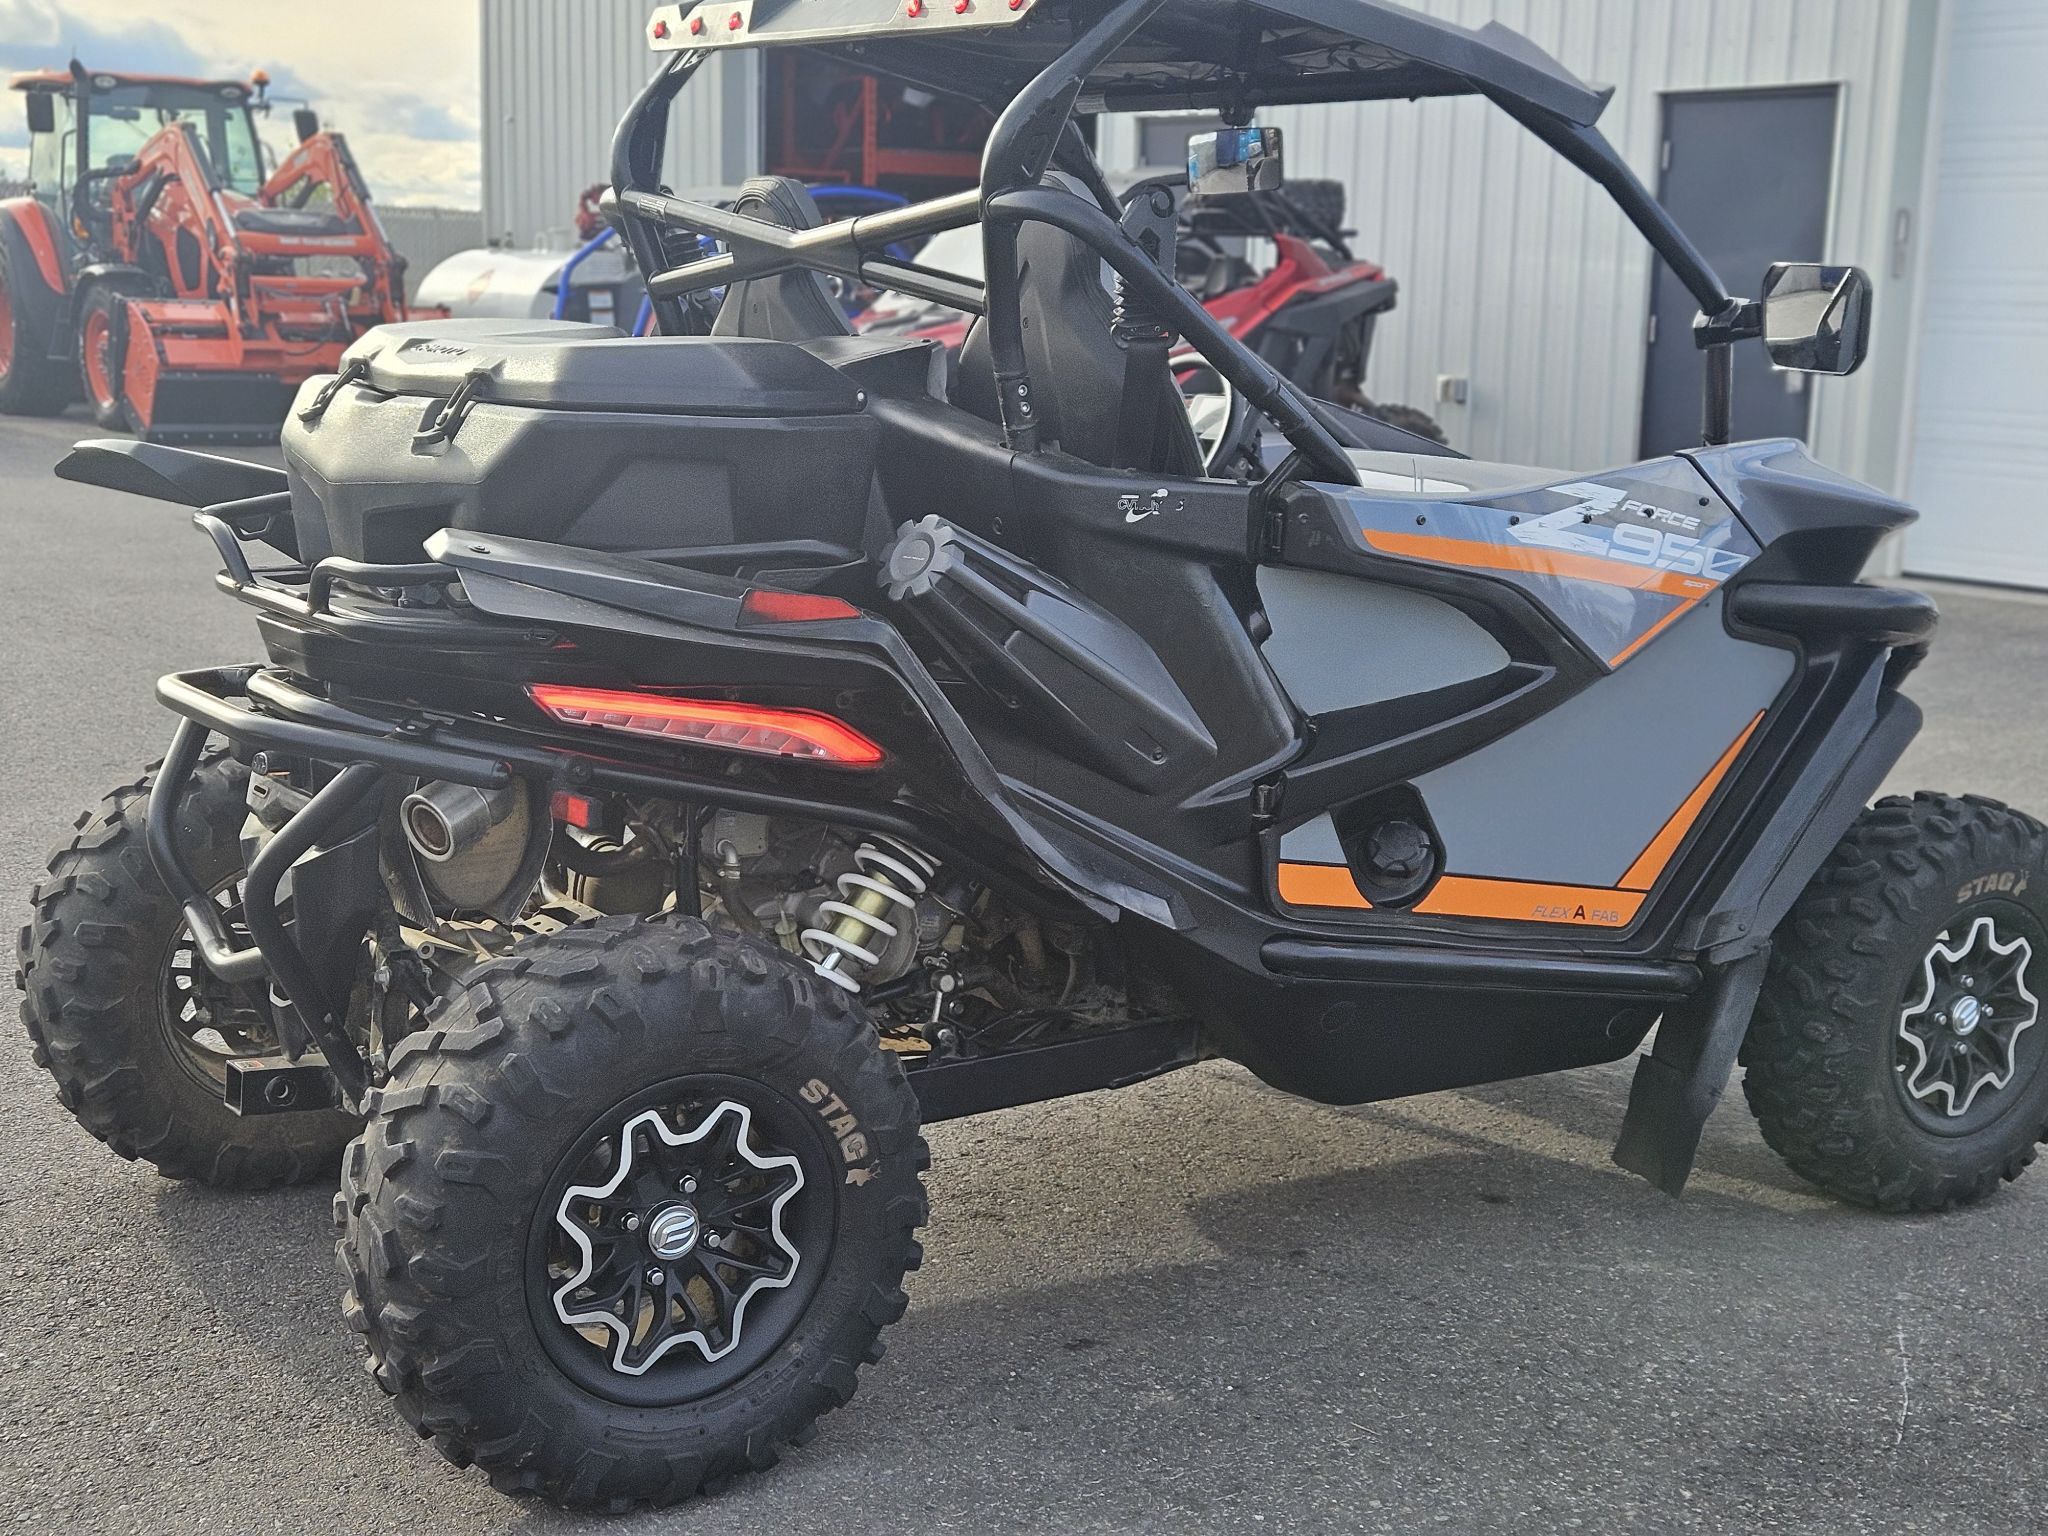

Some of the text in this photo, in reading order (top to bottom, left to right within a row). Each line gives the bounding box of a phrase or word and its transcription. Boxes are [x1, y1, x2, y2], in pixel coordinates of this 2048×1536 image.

[1621, 499, 1701, 530] FORCE
[1956, 871, 2015, 904] STAG
[1532, 905, 1619, 922] FLEX A FAB
[799, 1078, 869, 1164] STAG
